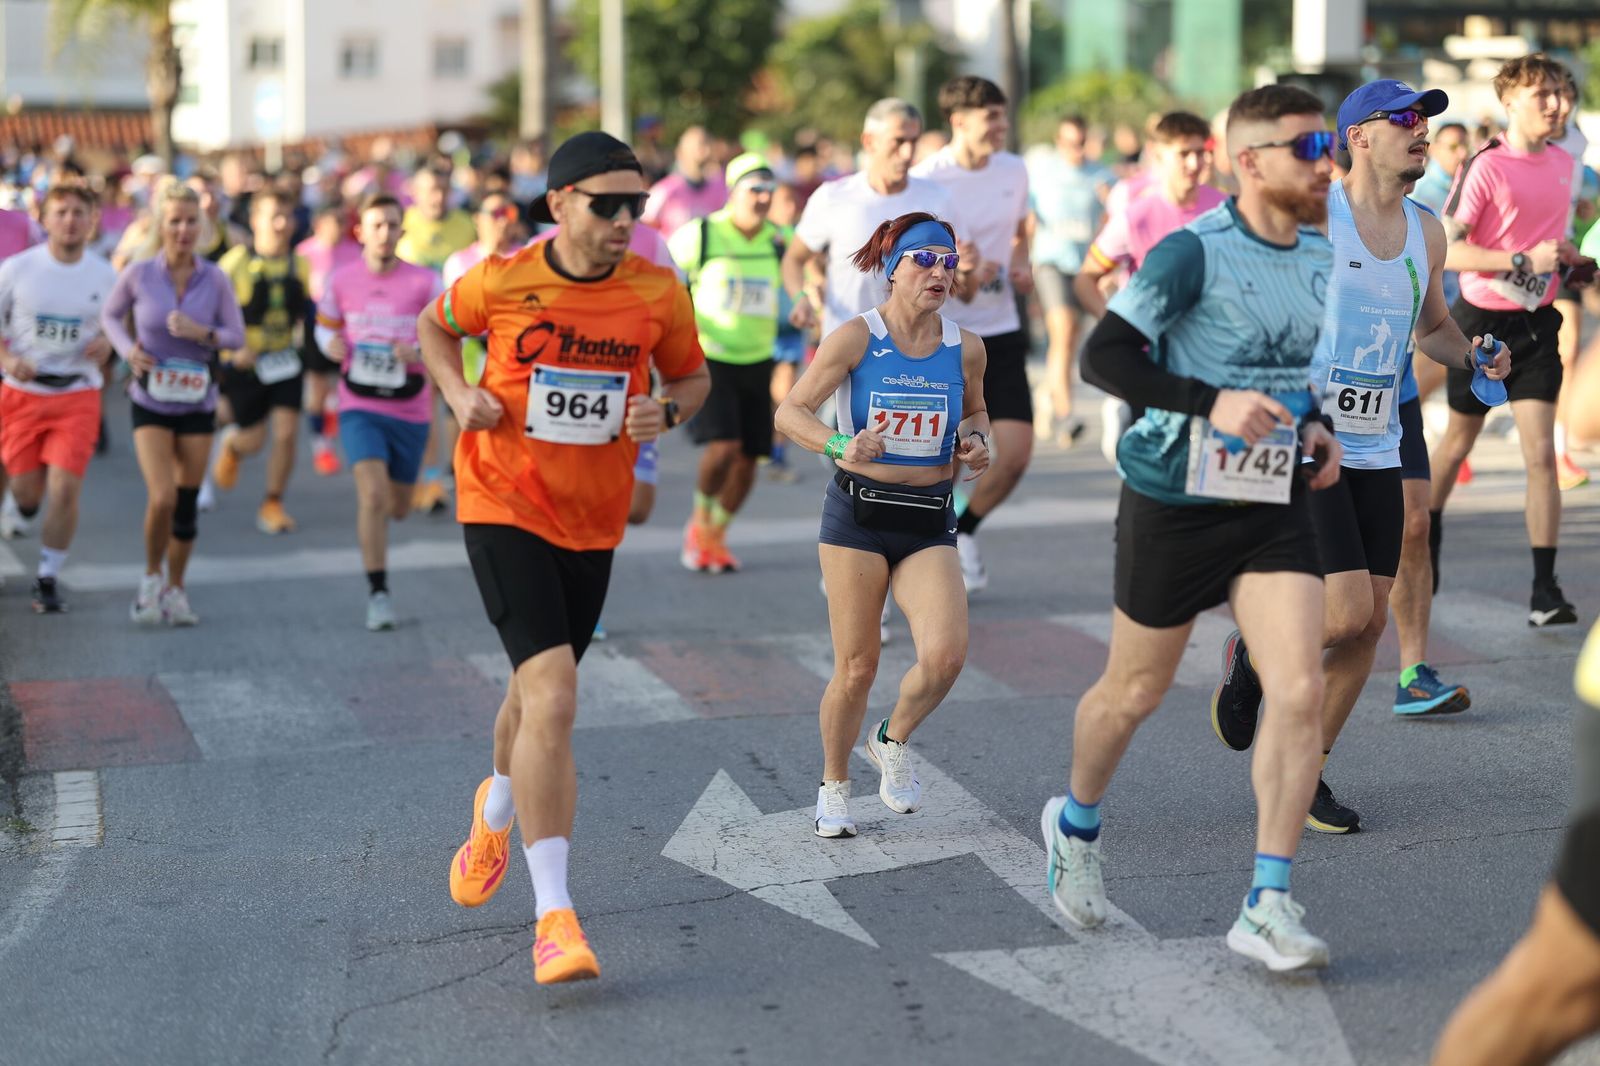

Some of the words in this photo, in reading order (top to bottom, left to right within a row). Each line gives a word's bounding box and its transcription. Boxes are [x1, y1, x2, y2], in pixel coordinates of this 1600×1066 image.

[900, 374, 925, 383] CLUB
[546, 391, 609, 420] 964
[1337, 387, 1384, 415] 611
[874, 410, 940, 437] 1711
[1215, 446, 1290, 477] 1742
